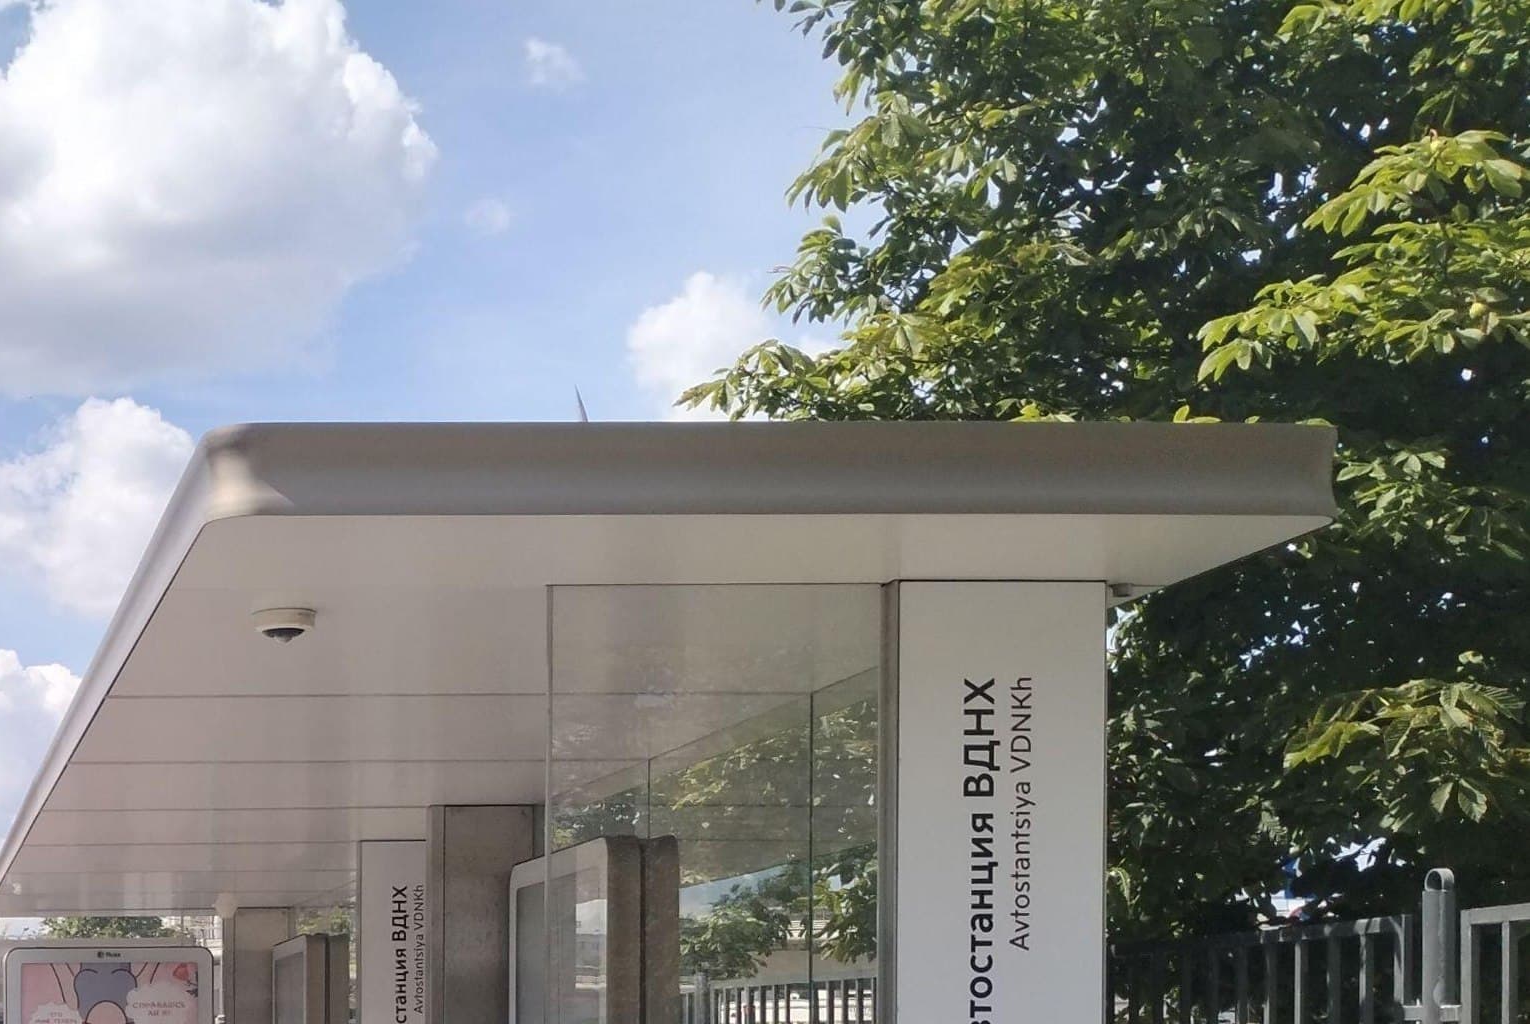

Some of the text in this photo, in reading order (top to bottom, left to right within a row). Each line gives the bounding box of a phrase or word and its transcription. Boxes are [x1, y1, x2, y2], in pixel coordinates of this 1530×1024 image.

[962, 677, 1001, 798] ВДНХ
[1008, 676, 1037, 951] Avtostantsiya VDNKh
[392, 885, 410, 942] ВДНХ
[413, 884, 426, 1014] Avtostantsiya VDNKh
